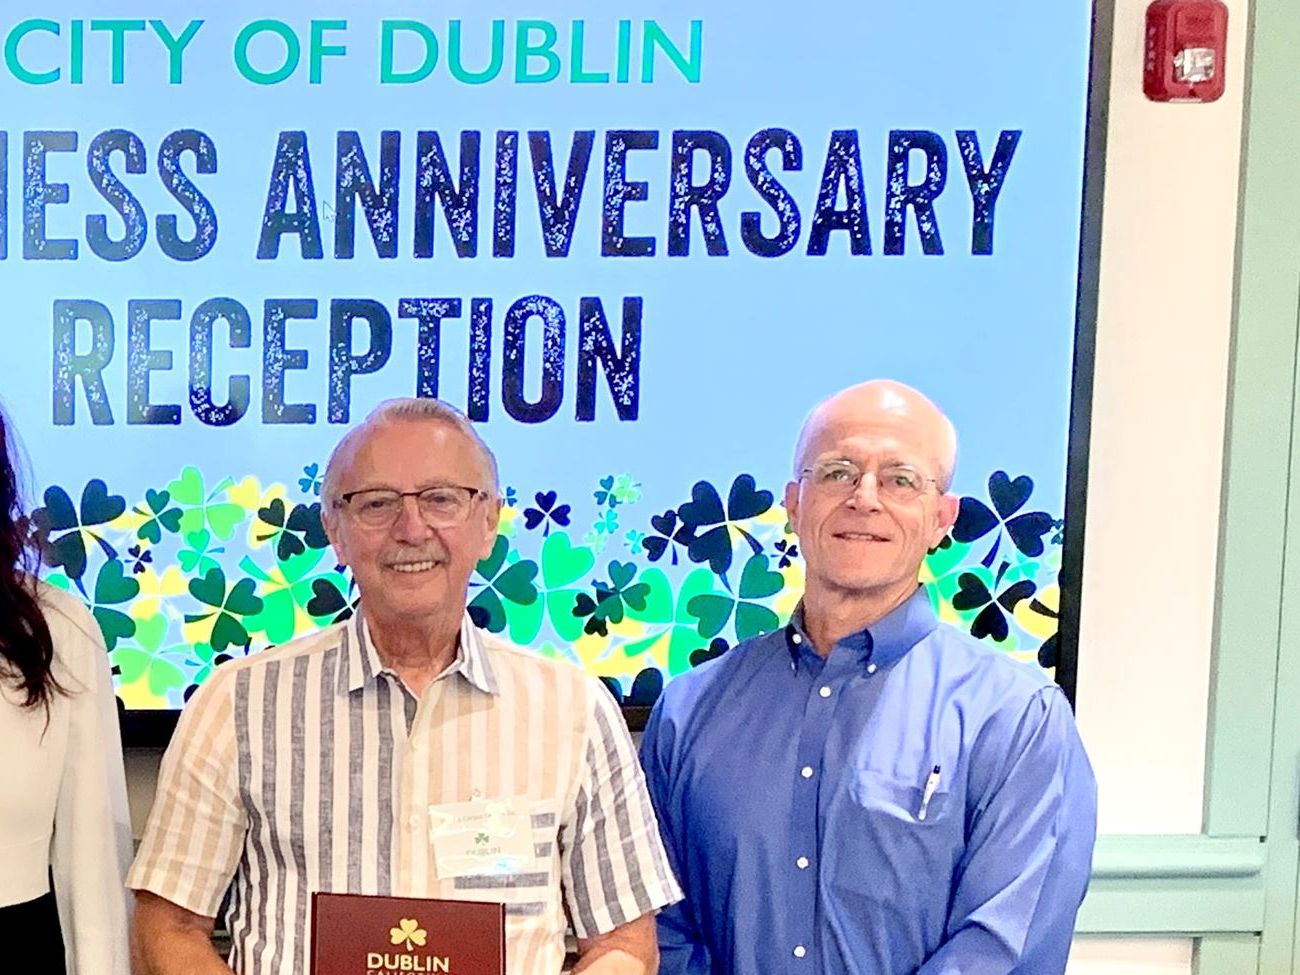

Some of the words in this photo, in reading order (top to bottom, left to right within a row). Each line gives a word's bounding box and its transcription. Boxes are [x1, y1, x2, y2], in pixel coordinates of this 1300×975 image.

[3, 18, 204, 84] CITY
[233, 18, 347, 84] OF
[379, 18, 703, 84] DUBLIN
[256, 127, 1023, 260] ANNIVERSARY
[52, 295, 643, 426] RECEPTION
[367, 952, 450, 973] DUBLIN
